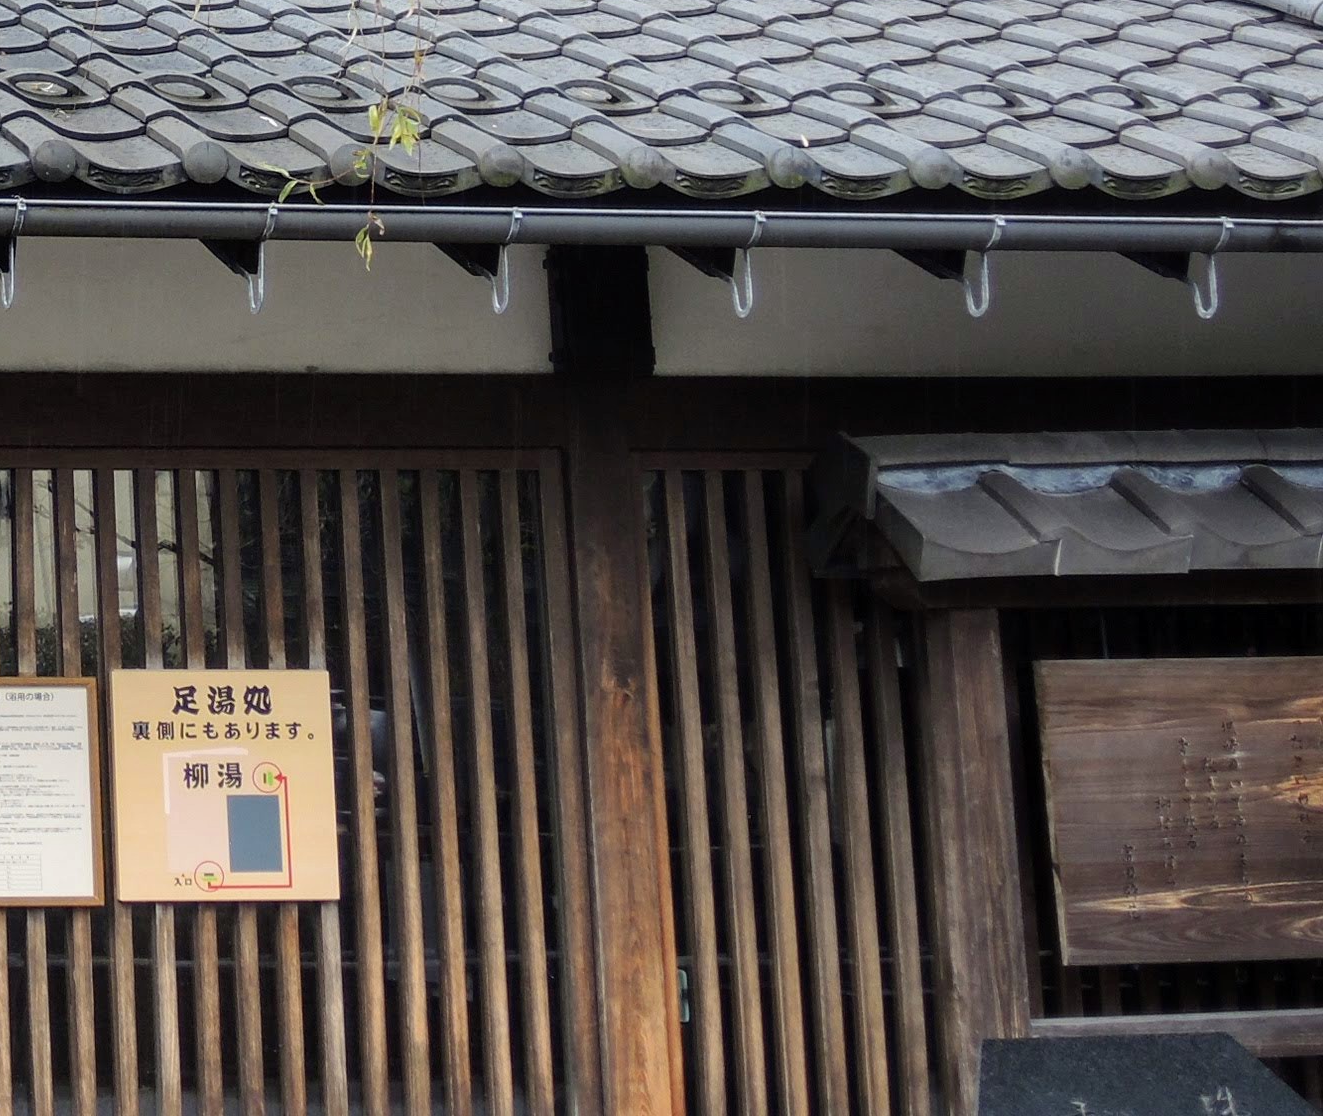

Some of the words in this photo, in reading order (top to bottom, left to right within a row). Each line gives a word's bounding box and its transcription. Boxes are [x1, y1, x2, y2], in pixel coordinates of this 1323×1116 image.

[171, 684, 273, 716] 足湯処
[131, 720, 316, 741] 裏側にもあります。
[183, 761, 244, 790] 柳湯
